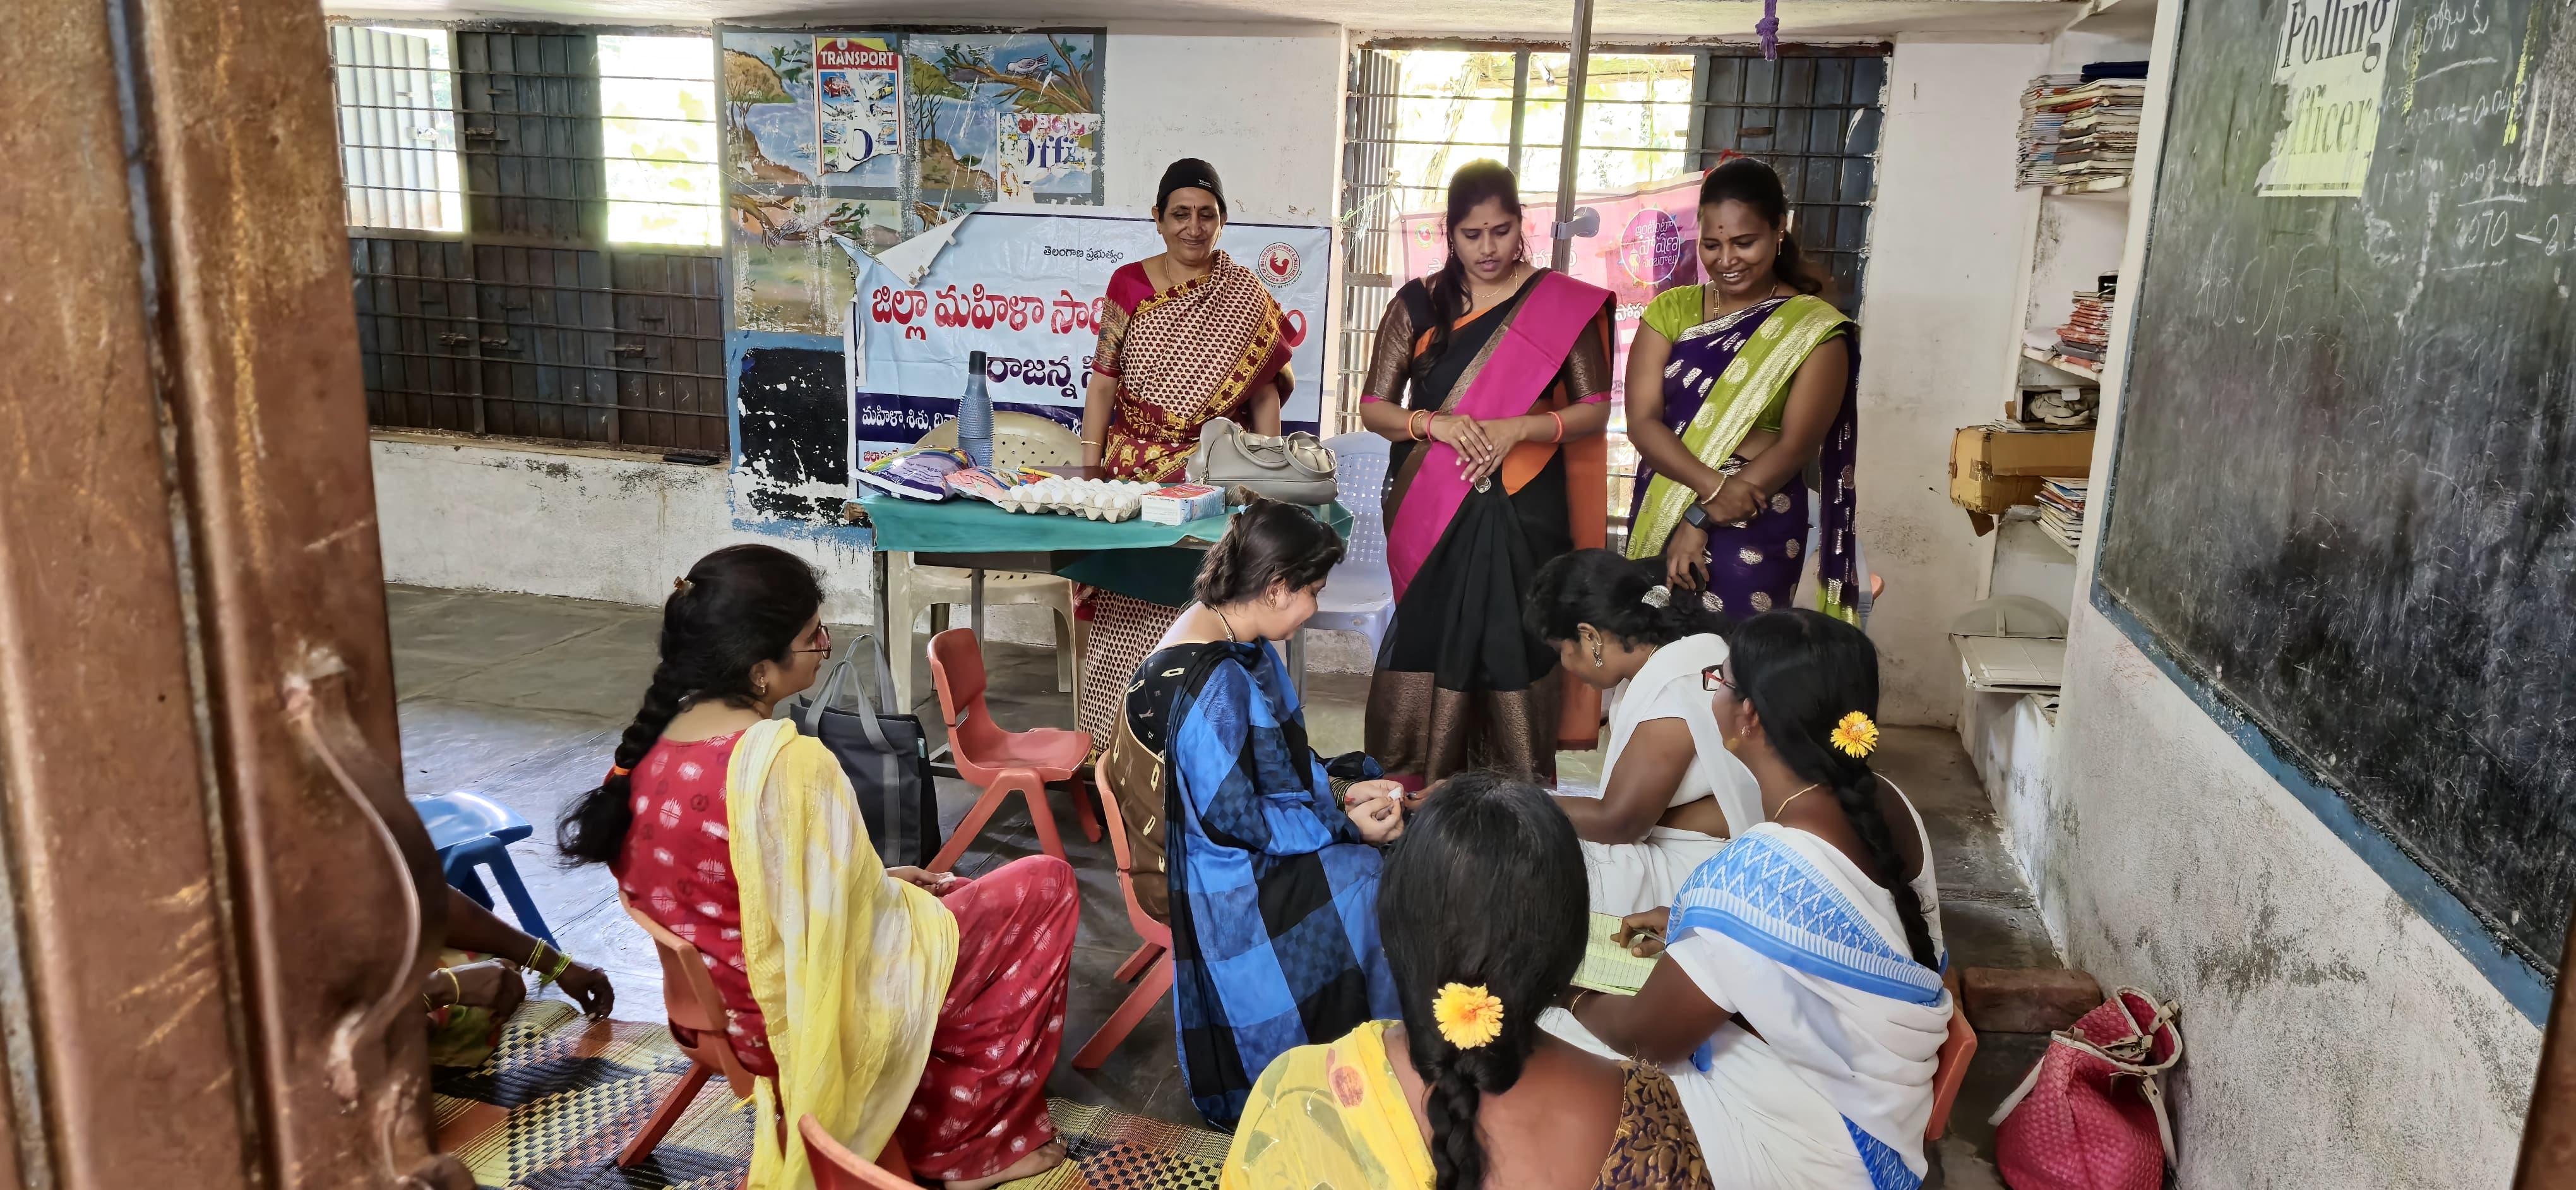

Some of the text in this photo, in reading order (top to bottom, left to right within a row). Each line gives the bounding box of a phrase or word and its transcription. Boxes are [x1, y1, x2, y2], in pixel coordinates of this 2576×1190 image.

[821, 51, 894, 66] TRANSPORT
[2281, 0, 2390, 73] Polling
[2277, 85, 2373, 155] fficer
[1044, 246, 1124, 263] తెలంగాణ ప్రభుత్వం
[872, 285, 927, 340] జిల్లా
[934, 283, 1044, 332] మహిళా
